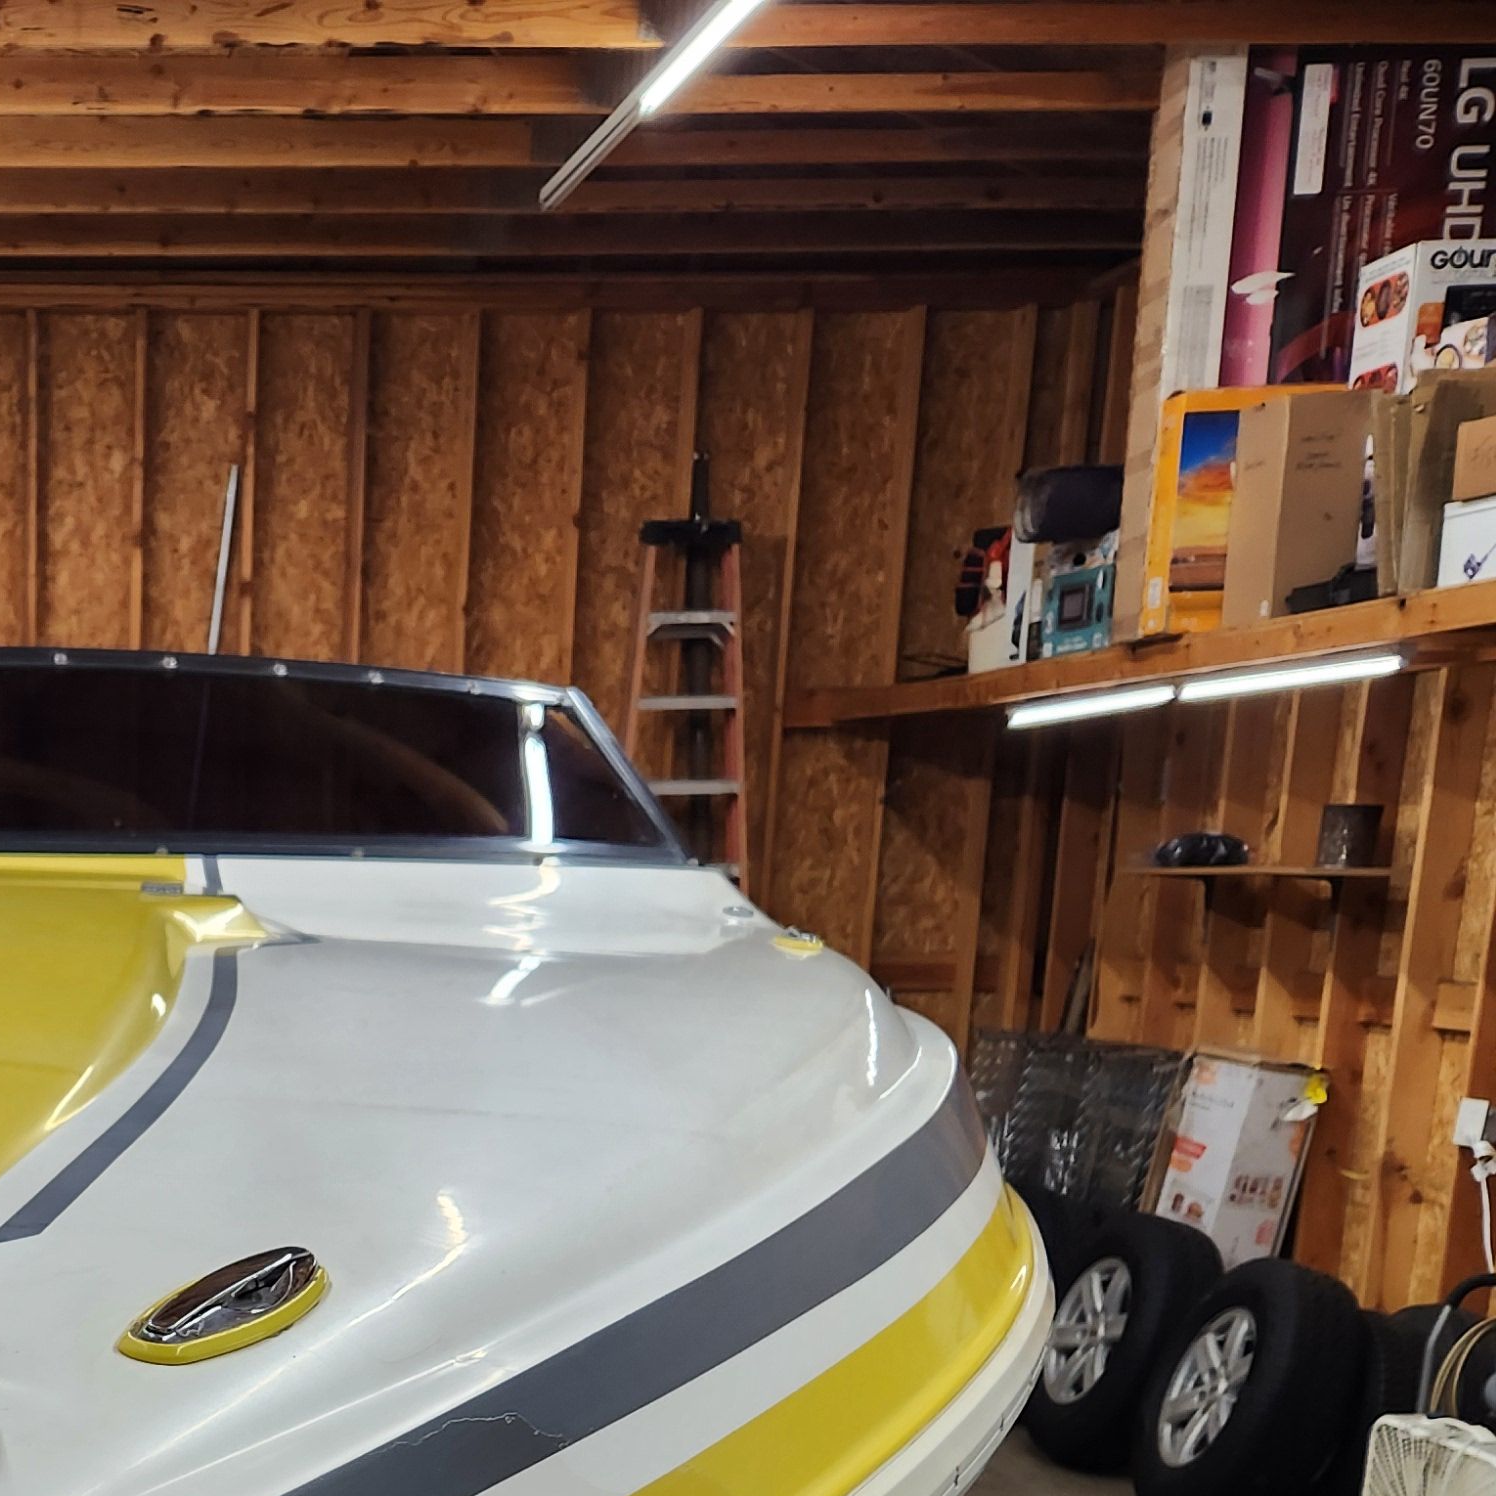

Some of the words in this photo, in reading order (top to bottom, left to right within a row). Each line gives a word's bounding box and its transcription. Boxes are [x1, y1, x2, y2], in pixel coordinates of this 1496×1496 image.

[1373, 90, 1387, 116] Core
[1376, 60, 1390, 89] Quad
[1415, 59, 1442, 150] 60UN70
[1456, 57, 1496, 124] LG
[1343, 113, 1361, 188] Entertainment
[1368, 117, 1384, 169] Processor
[1444, 144, 1491, 240] UHD
